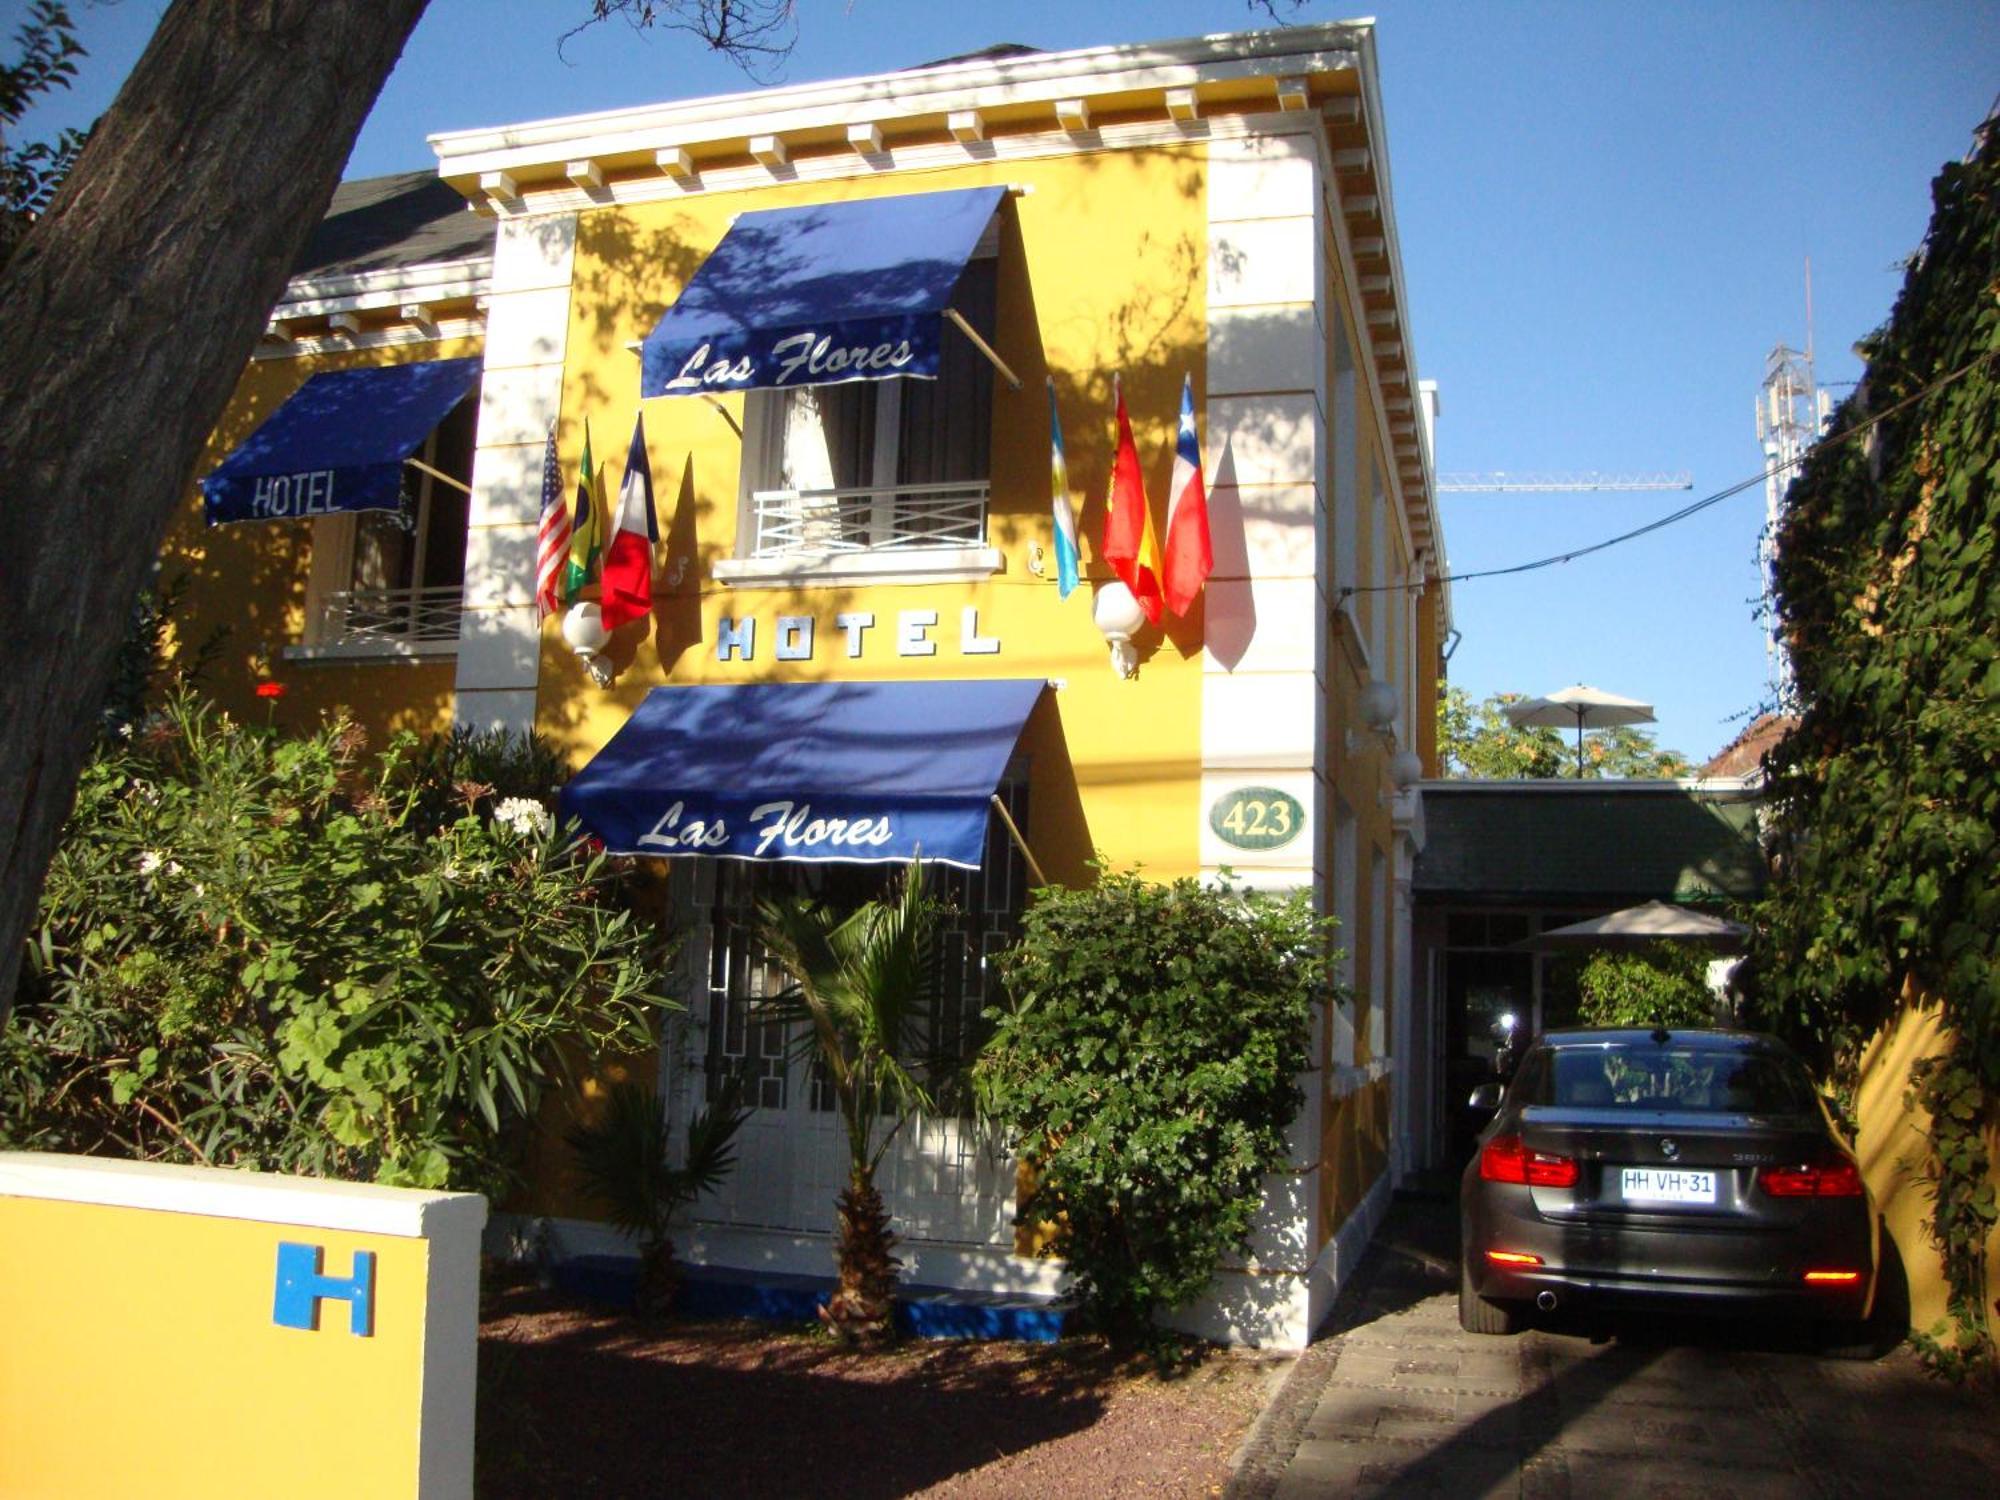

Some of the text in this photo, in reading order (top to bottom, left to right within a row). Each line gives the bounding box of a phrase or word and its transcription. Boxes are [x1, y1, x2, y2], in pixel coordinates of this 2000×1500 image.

[665, 333, 914, 390] Las Flores
[252, 470, 343, 517] HOTEL
[717, 606, 1000, 660] HOTEL
[637, 800, 893, 856] Las Flores
[1223, 800, 1291, 836] 423
